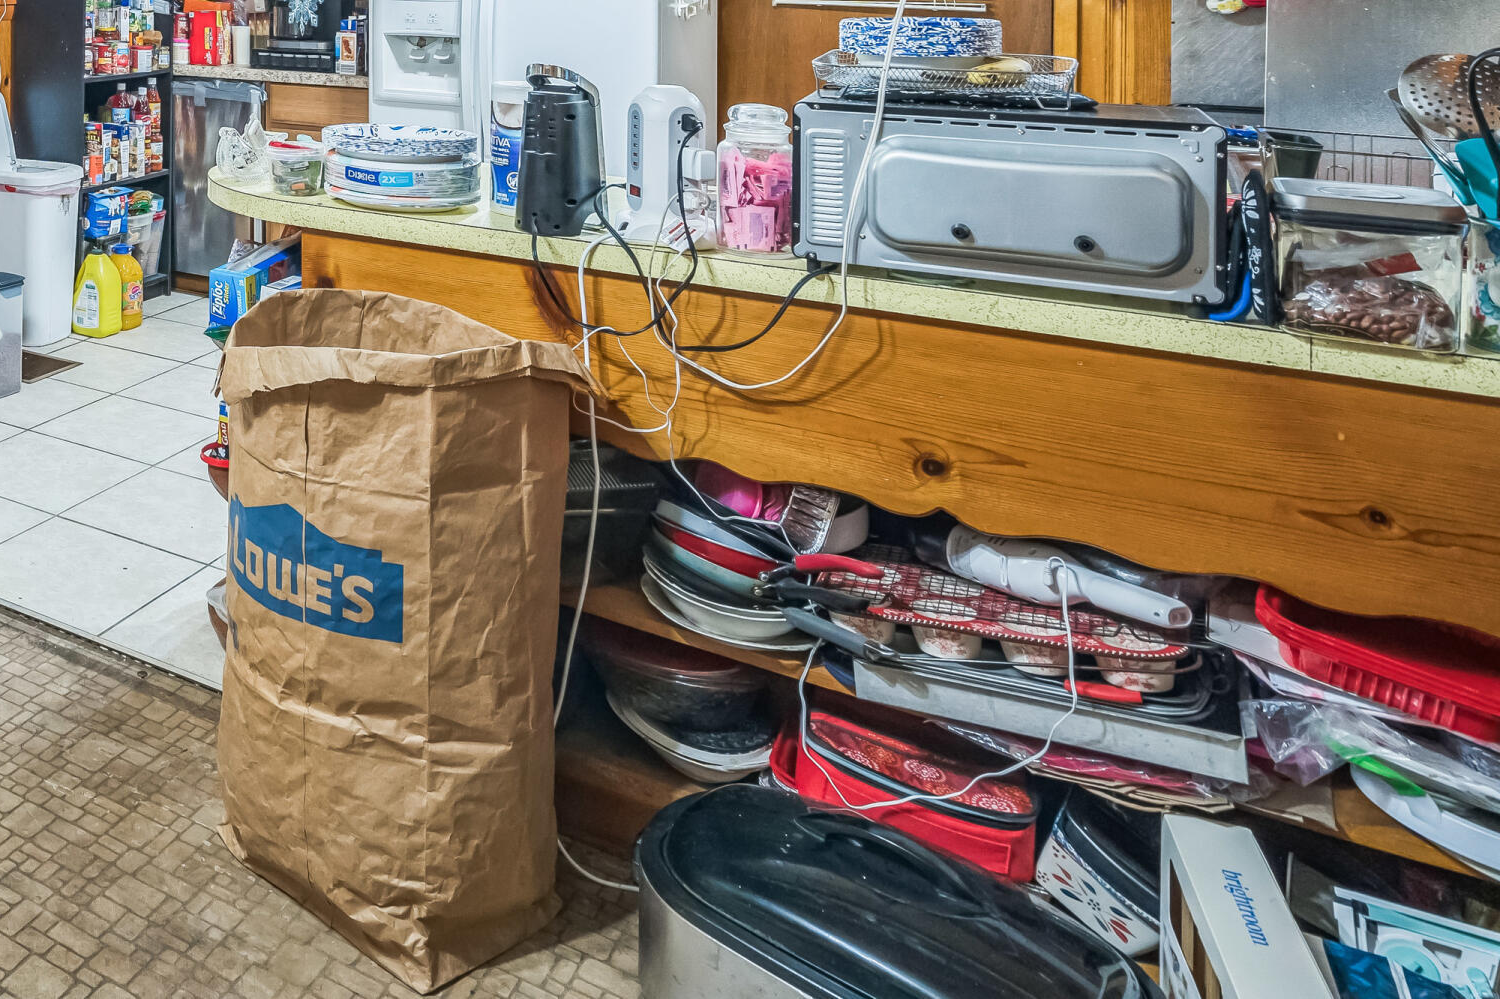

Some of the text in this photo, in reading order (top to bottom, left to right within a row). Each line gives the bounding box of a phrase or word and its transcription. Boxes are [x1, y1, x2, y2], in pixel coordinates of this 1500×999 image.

[491, 135, 511, 148] TIVA
[381, 175, 397, 184] 2X
[212, 280, 226, 316] Ziploc
[220, 422, 229, 446] GLAD
[233, 514, 375, 624] LOWE'S
[1221, 869, 1269, 947] brightroom
